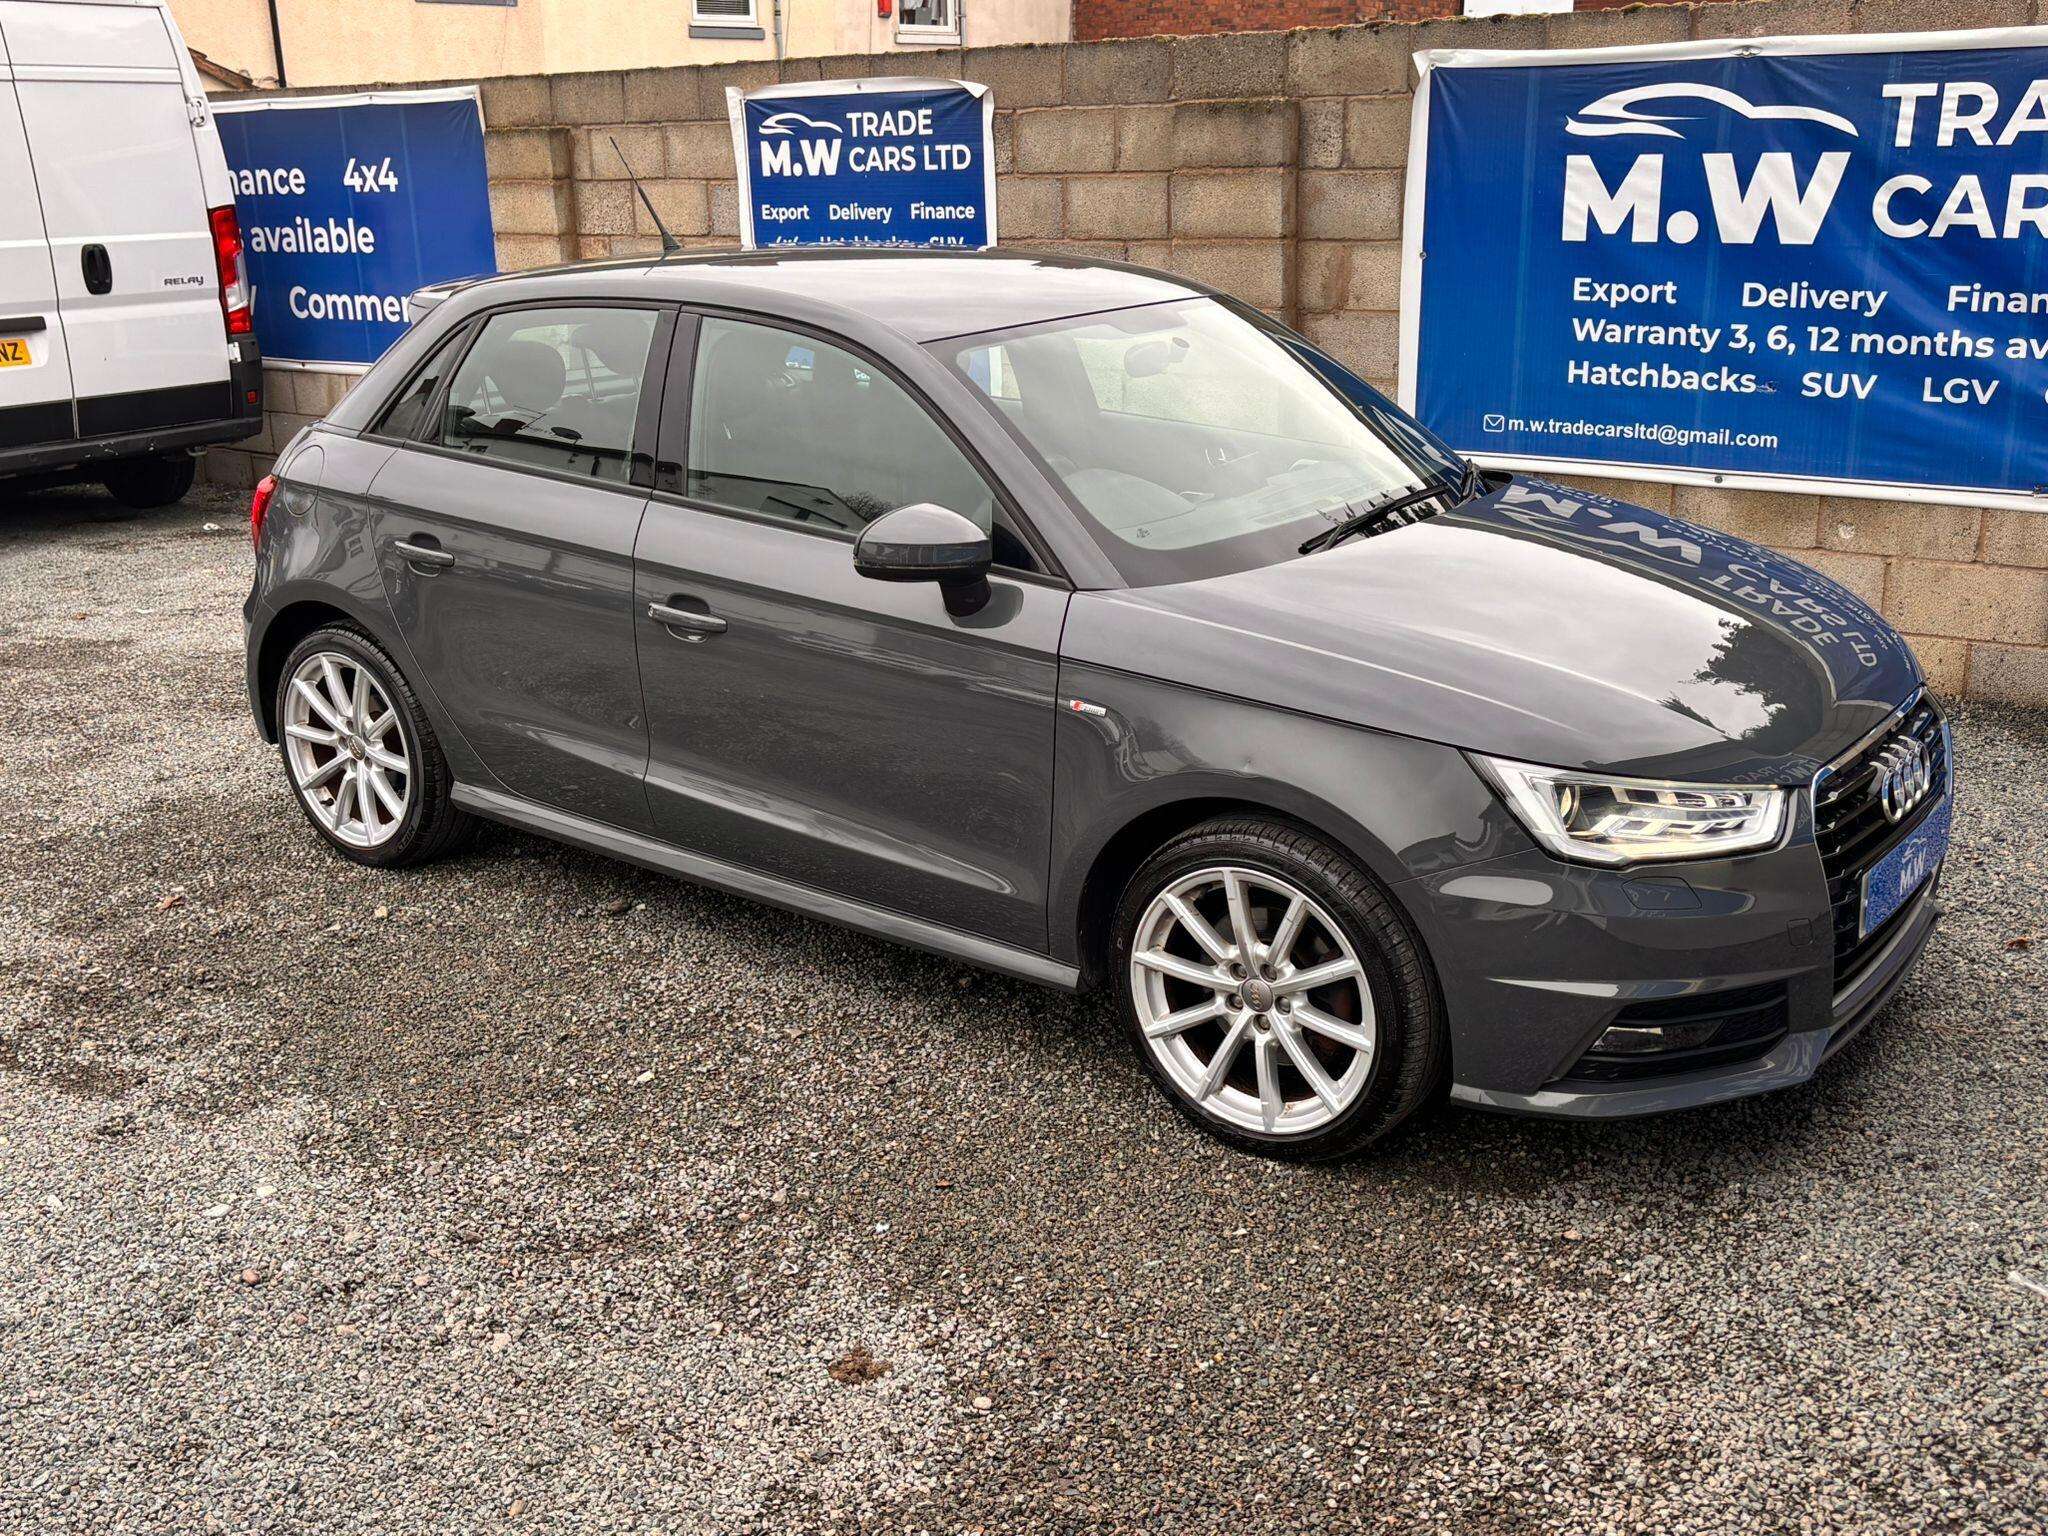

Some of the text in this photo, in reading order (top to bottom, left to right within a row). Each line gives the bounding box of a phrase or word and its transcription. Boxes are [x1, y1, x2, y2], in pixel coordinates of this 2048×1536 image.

[846, 109, 933, 138] TRADE
[1882, 79, 2048, 148] TRA
[343, 157, 399, 192] 4x4
[760, 138, 842, 178] M.W
[848, 144, 972, 173] CARS LTD
[761, 201, 976, 224] Export Delivery Finance
[1561, 151, 1852, 246] M.W
[1871, 174, 2048, 239] CAR
[250, 216, 375, 254] available
[164, 276, 204, 286] RELAY
[1573, 276, 2048, 317] Export Delivery Finan
[1572, 317, 1722, 353] Warranty
[1728, 323, 1757, 354] 3,
[1766, 325, 1796, 355] 6,
[1806, 326, 1840, 352] 12
[1850, 330, 1995, 358] months
[1567, 360, 2000, 405] Hatchbacks SUV LGV
[1508, 418, 1778, 448] m.w.tradecarsltd@gmail.com
